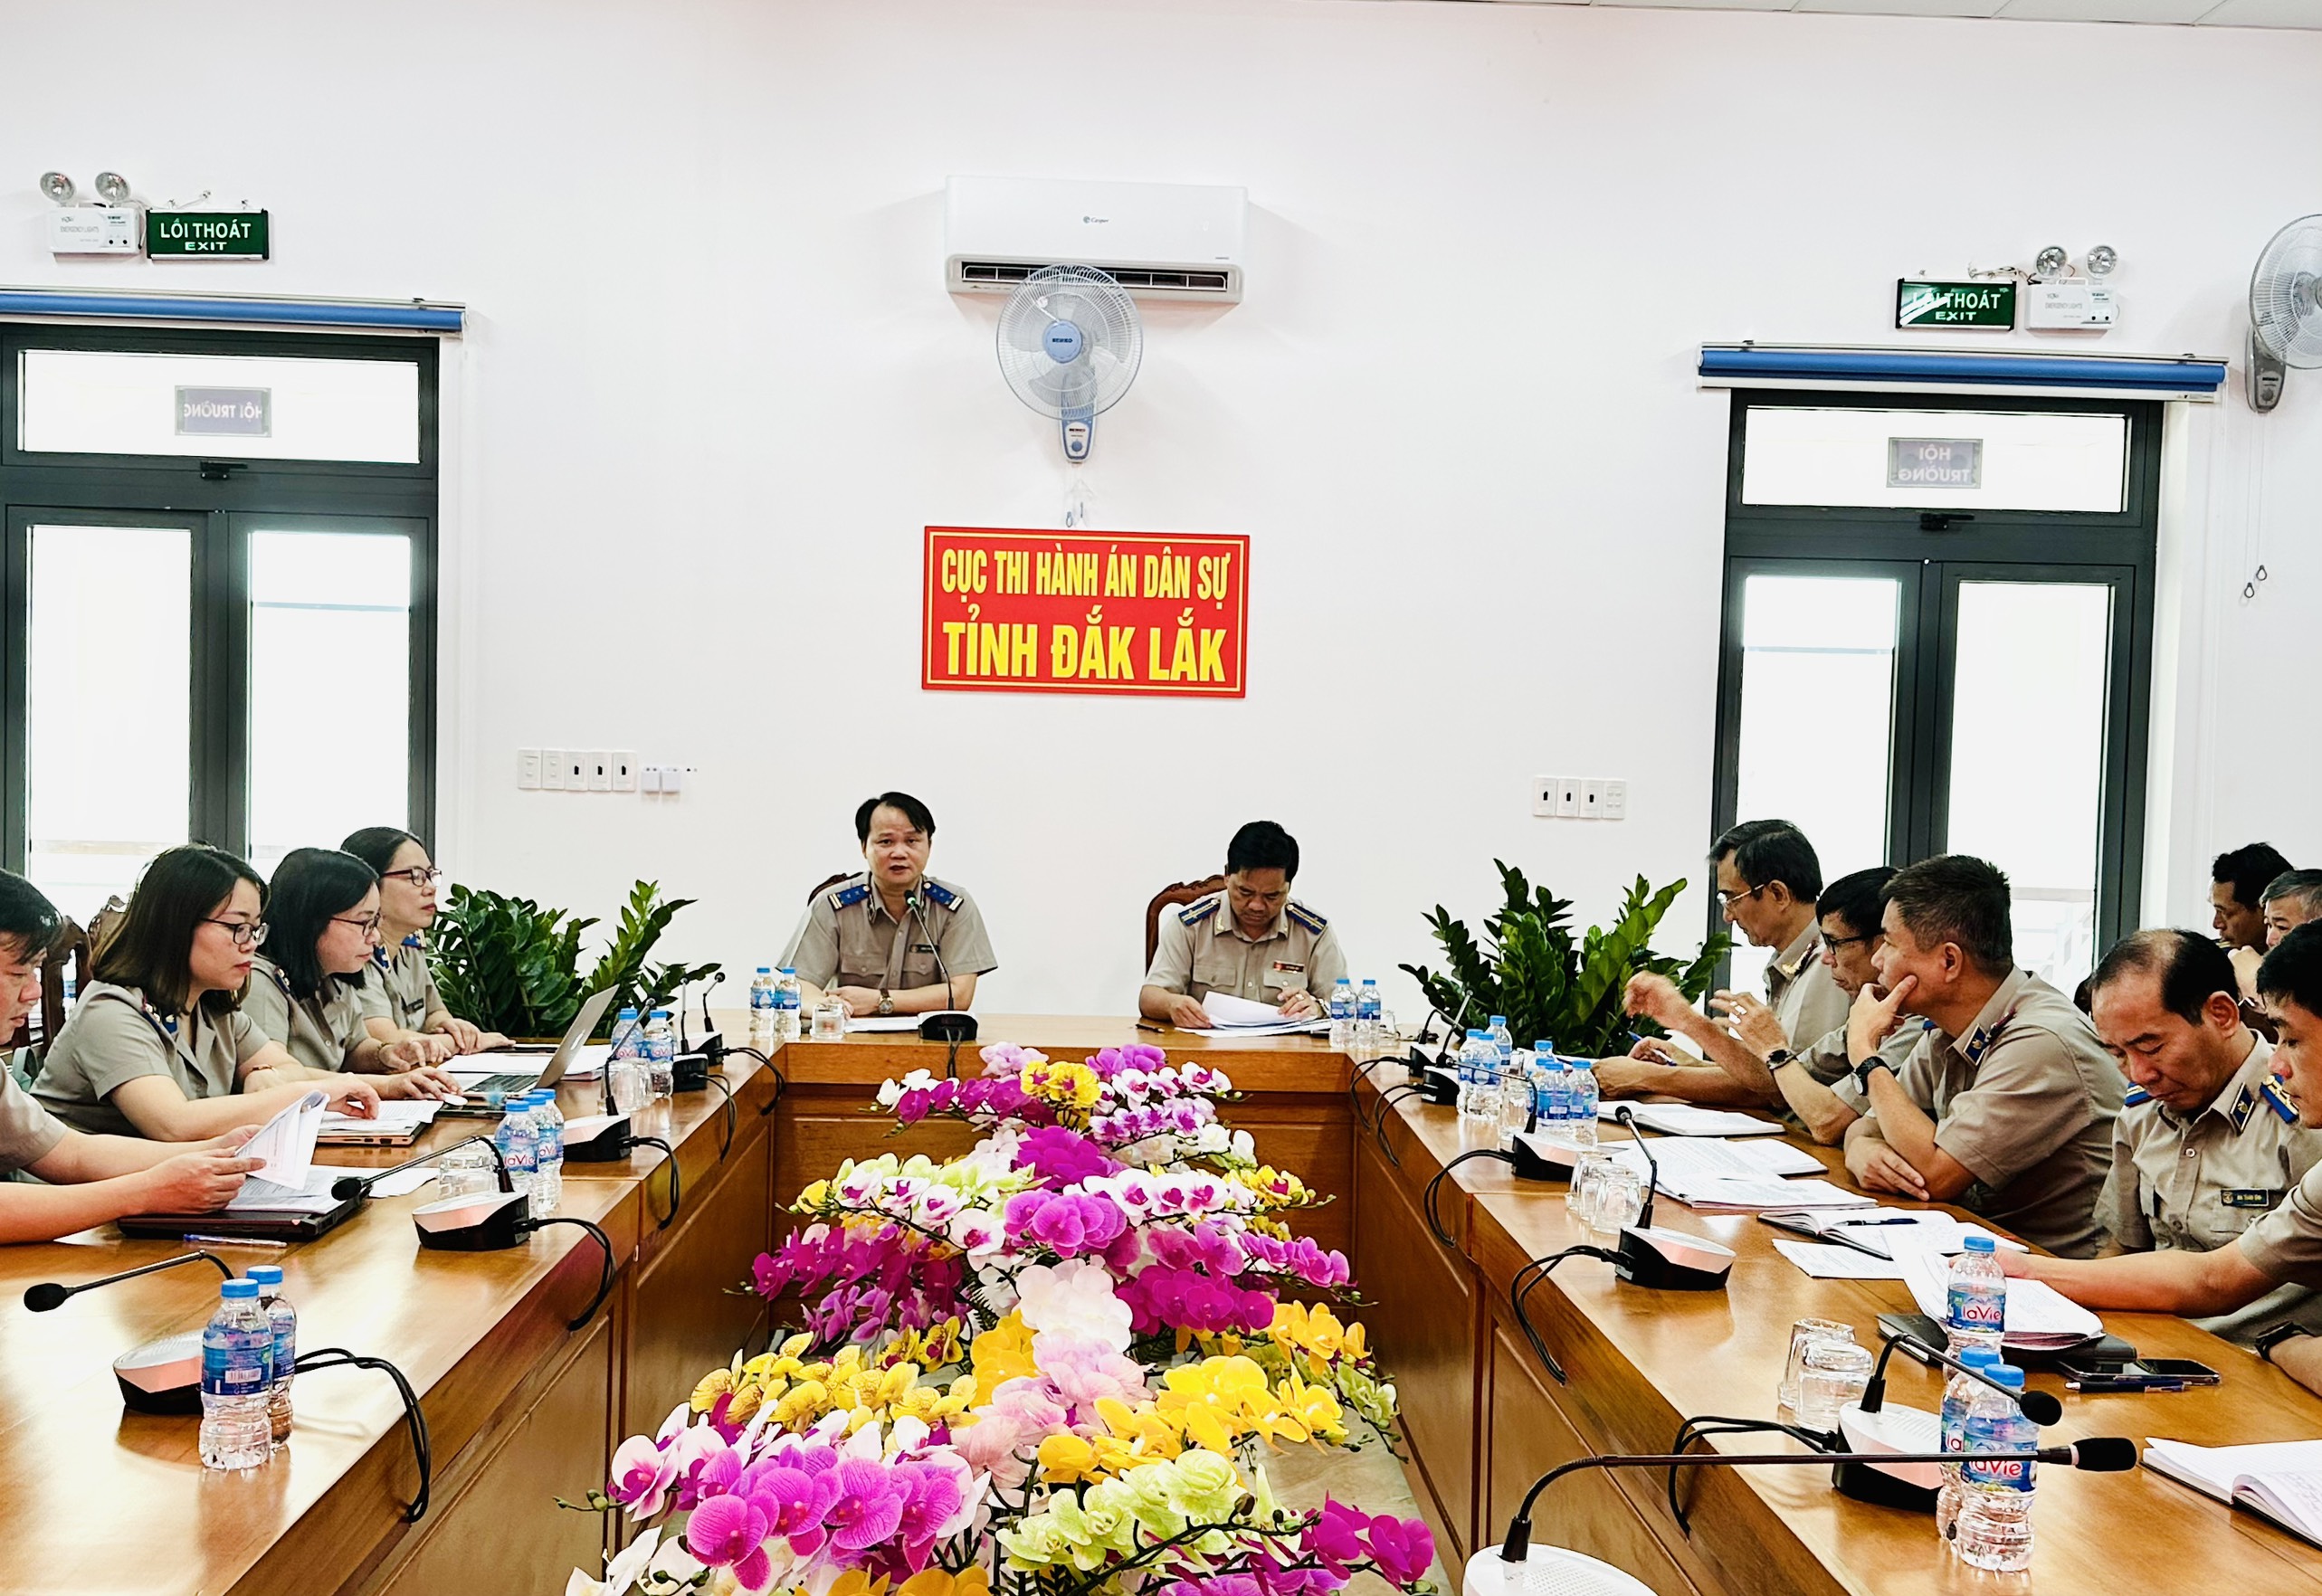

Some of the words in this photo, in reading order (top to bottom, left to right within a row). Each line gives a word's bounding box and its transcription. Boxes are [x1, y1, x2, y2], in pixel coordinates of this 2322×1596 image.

[160, 218, 188, 238] LỐI
[192, 219, 252, 238] THOÁT
[185, 242, 227, 251] EXIT
[1944, 290, 2001, 309] THOÁT
[1935, 311, 1976, 321] EXIT
[941, 548, 987, 603] CỤC
[994, 550, 1029, 594] THI
[1035, 543, 1099, 596] HÀNH
[1103, 544, 1137, 597] ÁN
[1143, 546, 1191, 599] DÂN
[1196, 552, 1232, 610] SỰ
[942, 603, 1038, 678] TỈNH
[1050, 604, 1137, 680] ĐẮK
[1148, 607, 1228, 682] LẮK
